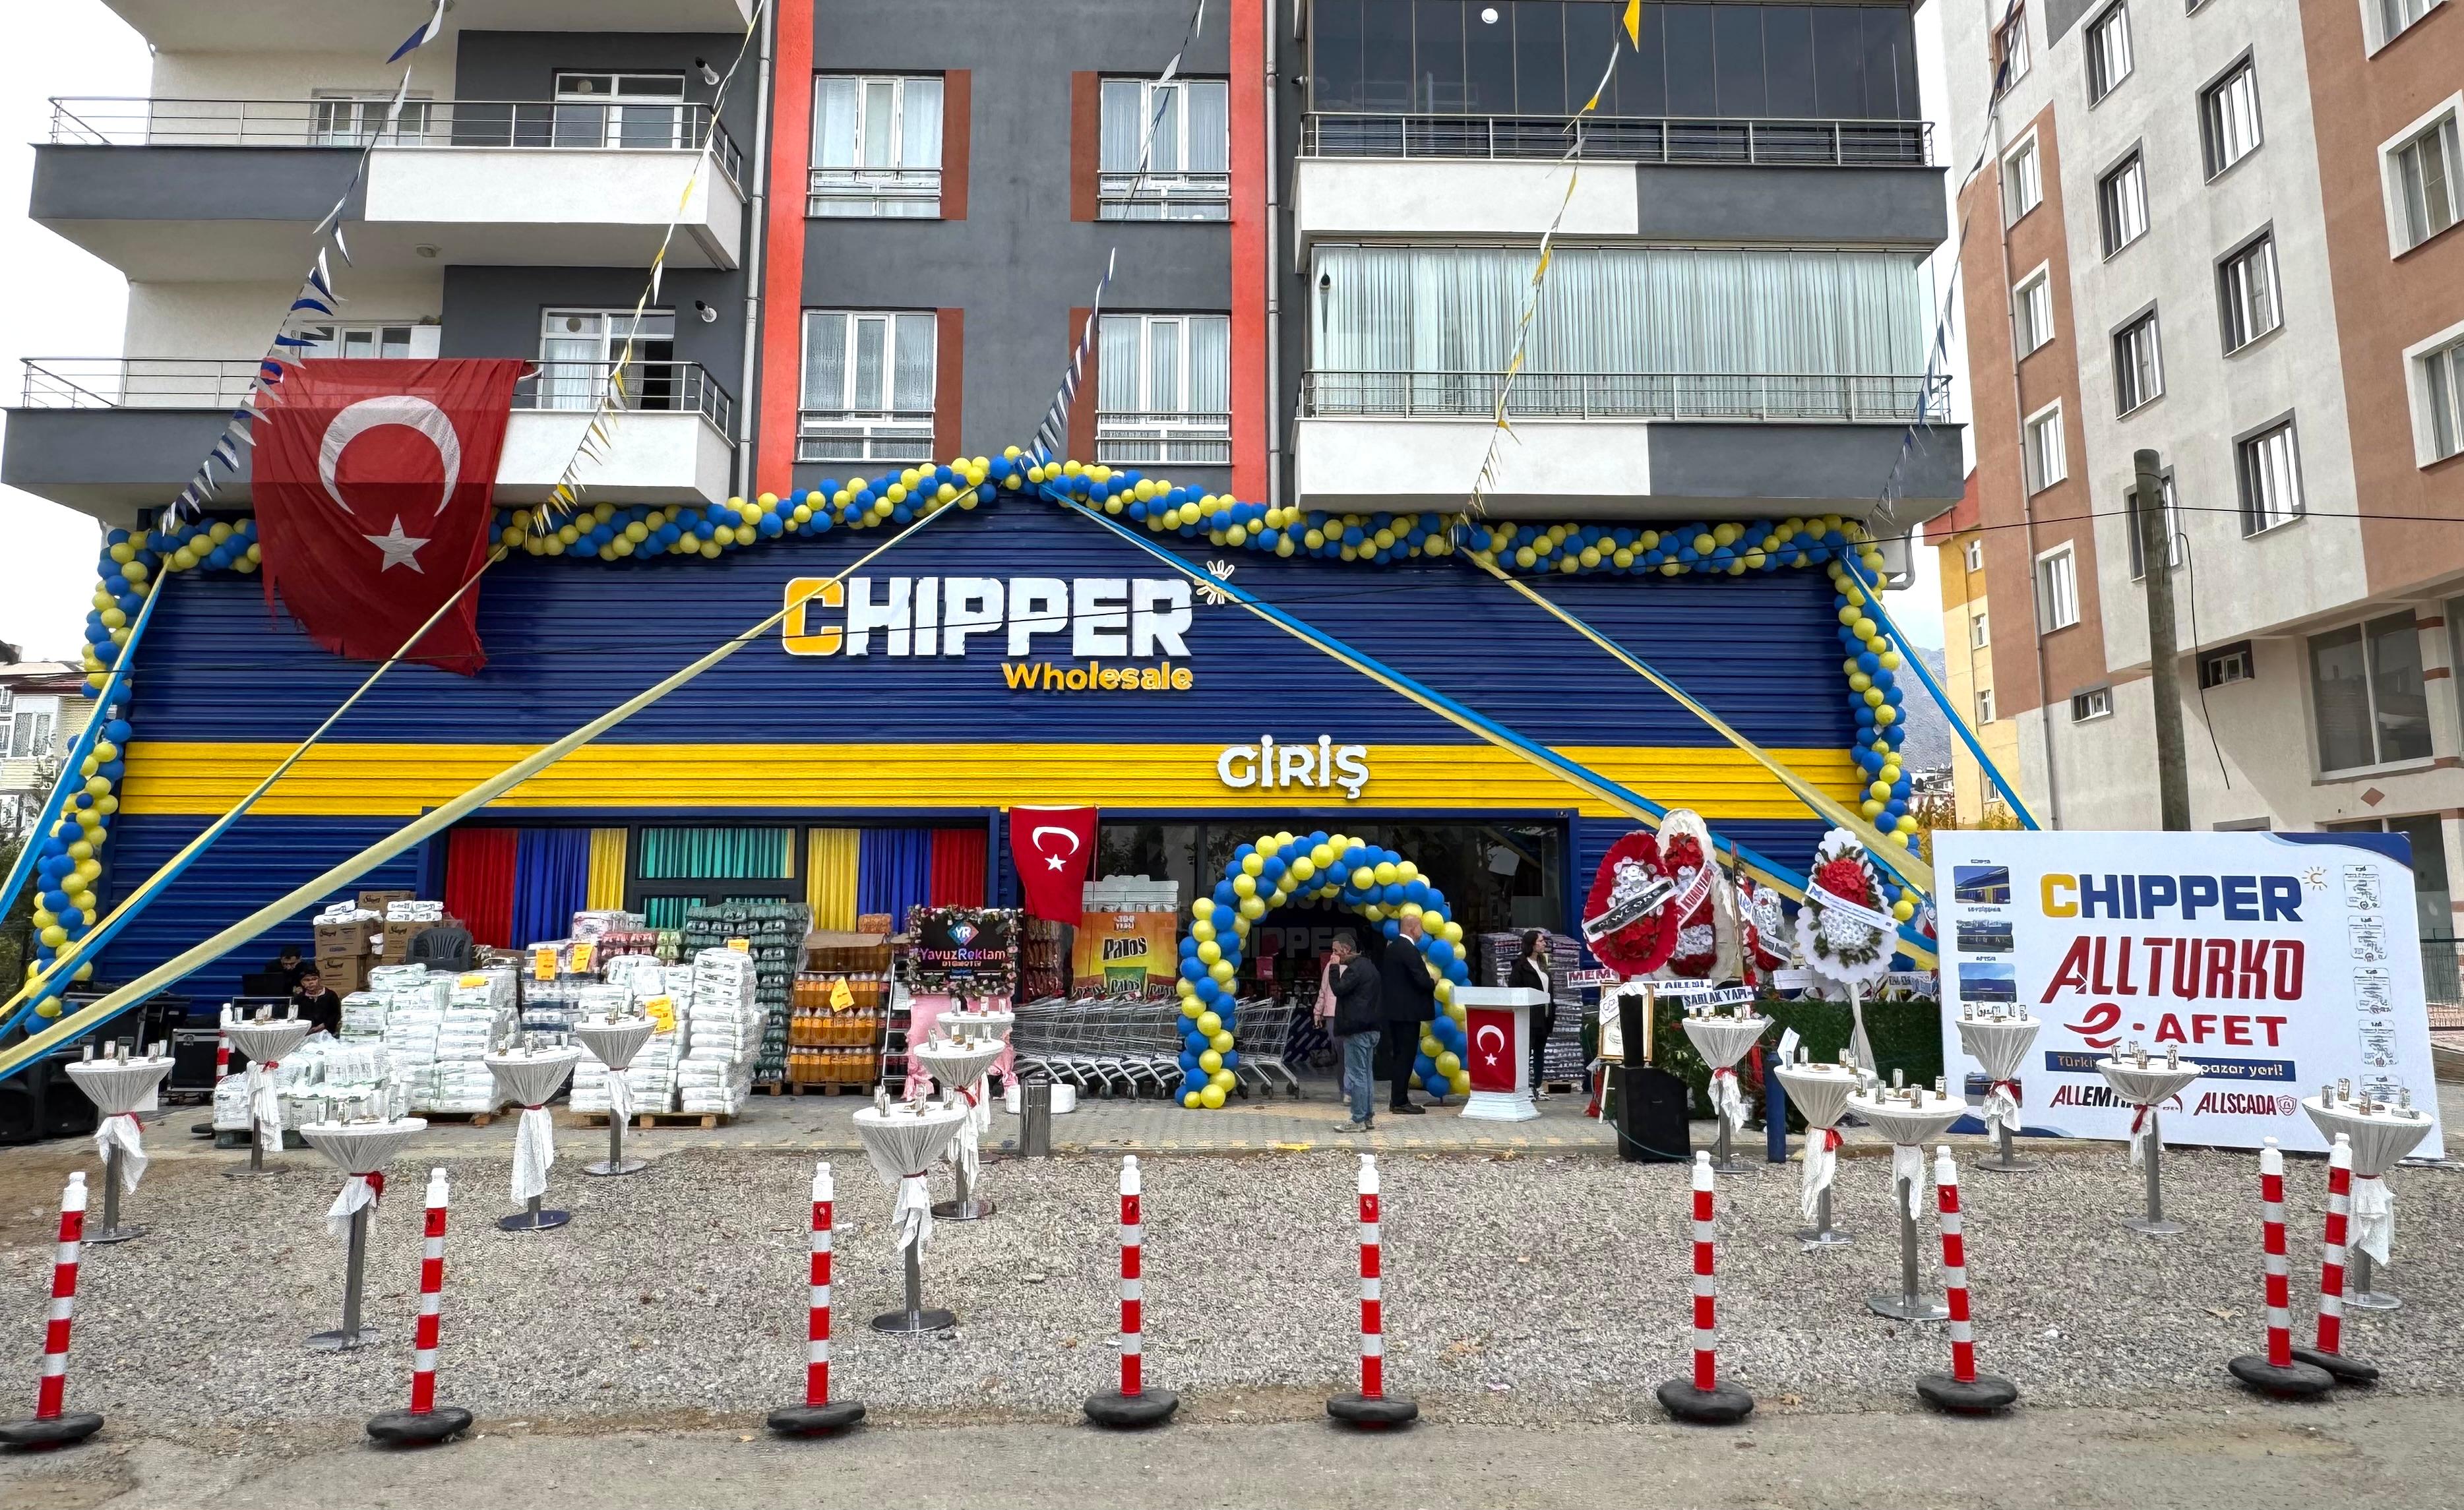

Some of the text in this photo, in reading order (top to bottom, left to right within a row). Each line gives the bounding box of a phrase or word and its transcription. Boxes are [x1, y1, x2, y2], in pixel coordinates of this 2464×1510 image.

[782, 577, 1192, 657] CHIPPER
[1001, 661, 1194, 691] Wholesale
[1217, 735, 1371, 799] GİRİŞ
[2041, 874, 2304, 922] CHIPPER
[955, 926, 971, 938] YR
[2194, 1091, 2277, 1116] ALLSCADA
